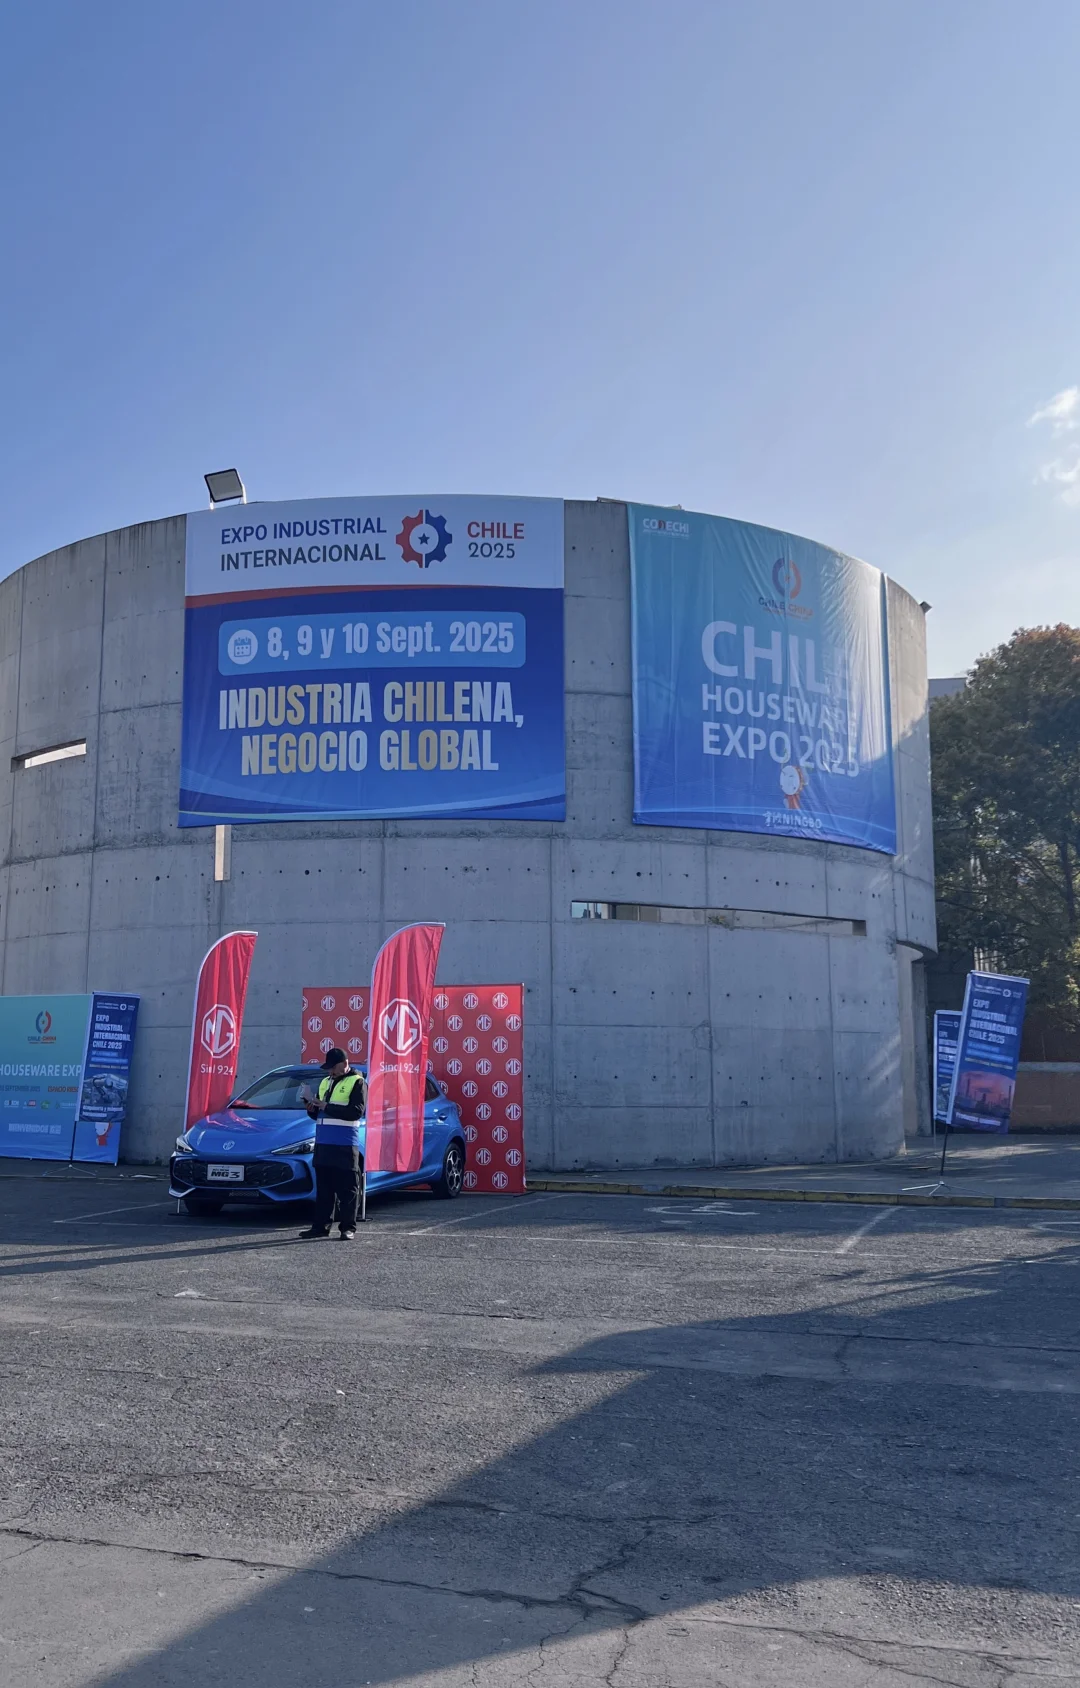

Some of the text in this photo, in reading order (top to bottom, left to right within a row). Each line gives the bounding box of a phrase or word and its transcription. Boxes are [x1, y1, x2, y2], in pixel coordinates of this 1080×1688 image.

[221, 517, 387, 544] EXPO INDUSTRIAL
[467, 522, 525, 540] CHILE
[221, 543, 386, 572] INTERNACIONAL
[468, 542, 516, 559] 2025
[267, 620, 514, 660] 8, 9 y 10 Sept. 2025
[219, 681, 524, 730] INDUSTRIA CHILENA,
[241, 729, 499, 776] NEGOCIO GLOBAL
[702, 721, 860, 778] EXPO 2025
[782, 814, 822, 828] NINGBO
[322, 996, 334, 1010] MG
[350, 996, 362, 1010] MG
[435, 995, 448, 1009] MG
[464, 994, 477, 1008] MG
[493, 994, 507, 1008] MG
[309, 1017, 321, 1031] MG
[336, 1017, 349, 1031] MG
[382, 1002, 420, 1053] MG
[448, 1016, 462, 1030] MG
[477, 1016, 491, 1030] MG
[507, 1015, 520, 1030] MG
[204, 1008, 234, 1055] MG
[349, 1038, 361, 1052] MG
[434, 1038, 447, 1052] MG
[464, 1038, 477, 1052] MG
[493, 1037, 507, 1052] MG
[62, 1064, 82, 1076] EXP
[448, 1060, 461, 1074] MG
[477, 1060, 491, 1074] MG
[506, 1060, 520, 1074] MG
[463, 1082, 477, 1096] MG
[493, 1082, 507, 1096] MG
[477, 1104, 490, 1119] MG
[507, 1104, 520, 1119] MG
[493, 1127, 507, 1142] MG
[477, 1149, 490, 1164] MG
[507, 1150, 520, 1165] MG
[493, 1172, 507, 1188] MG
